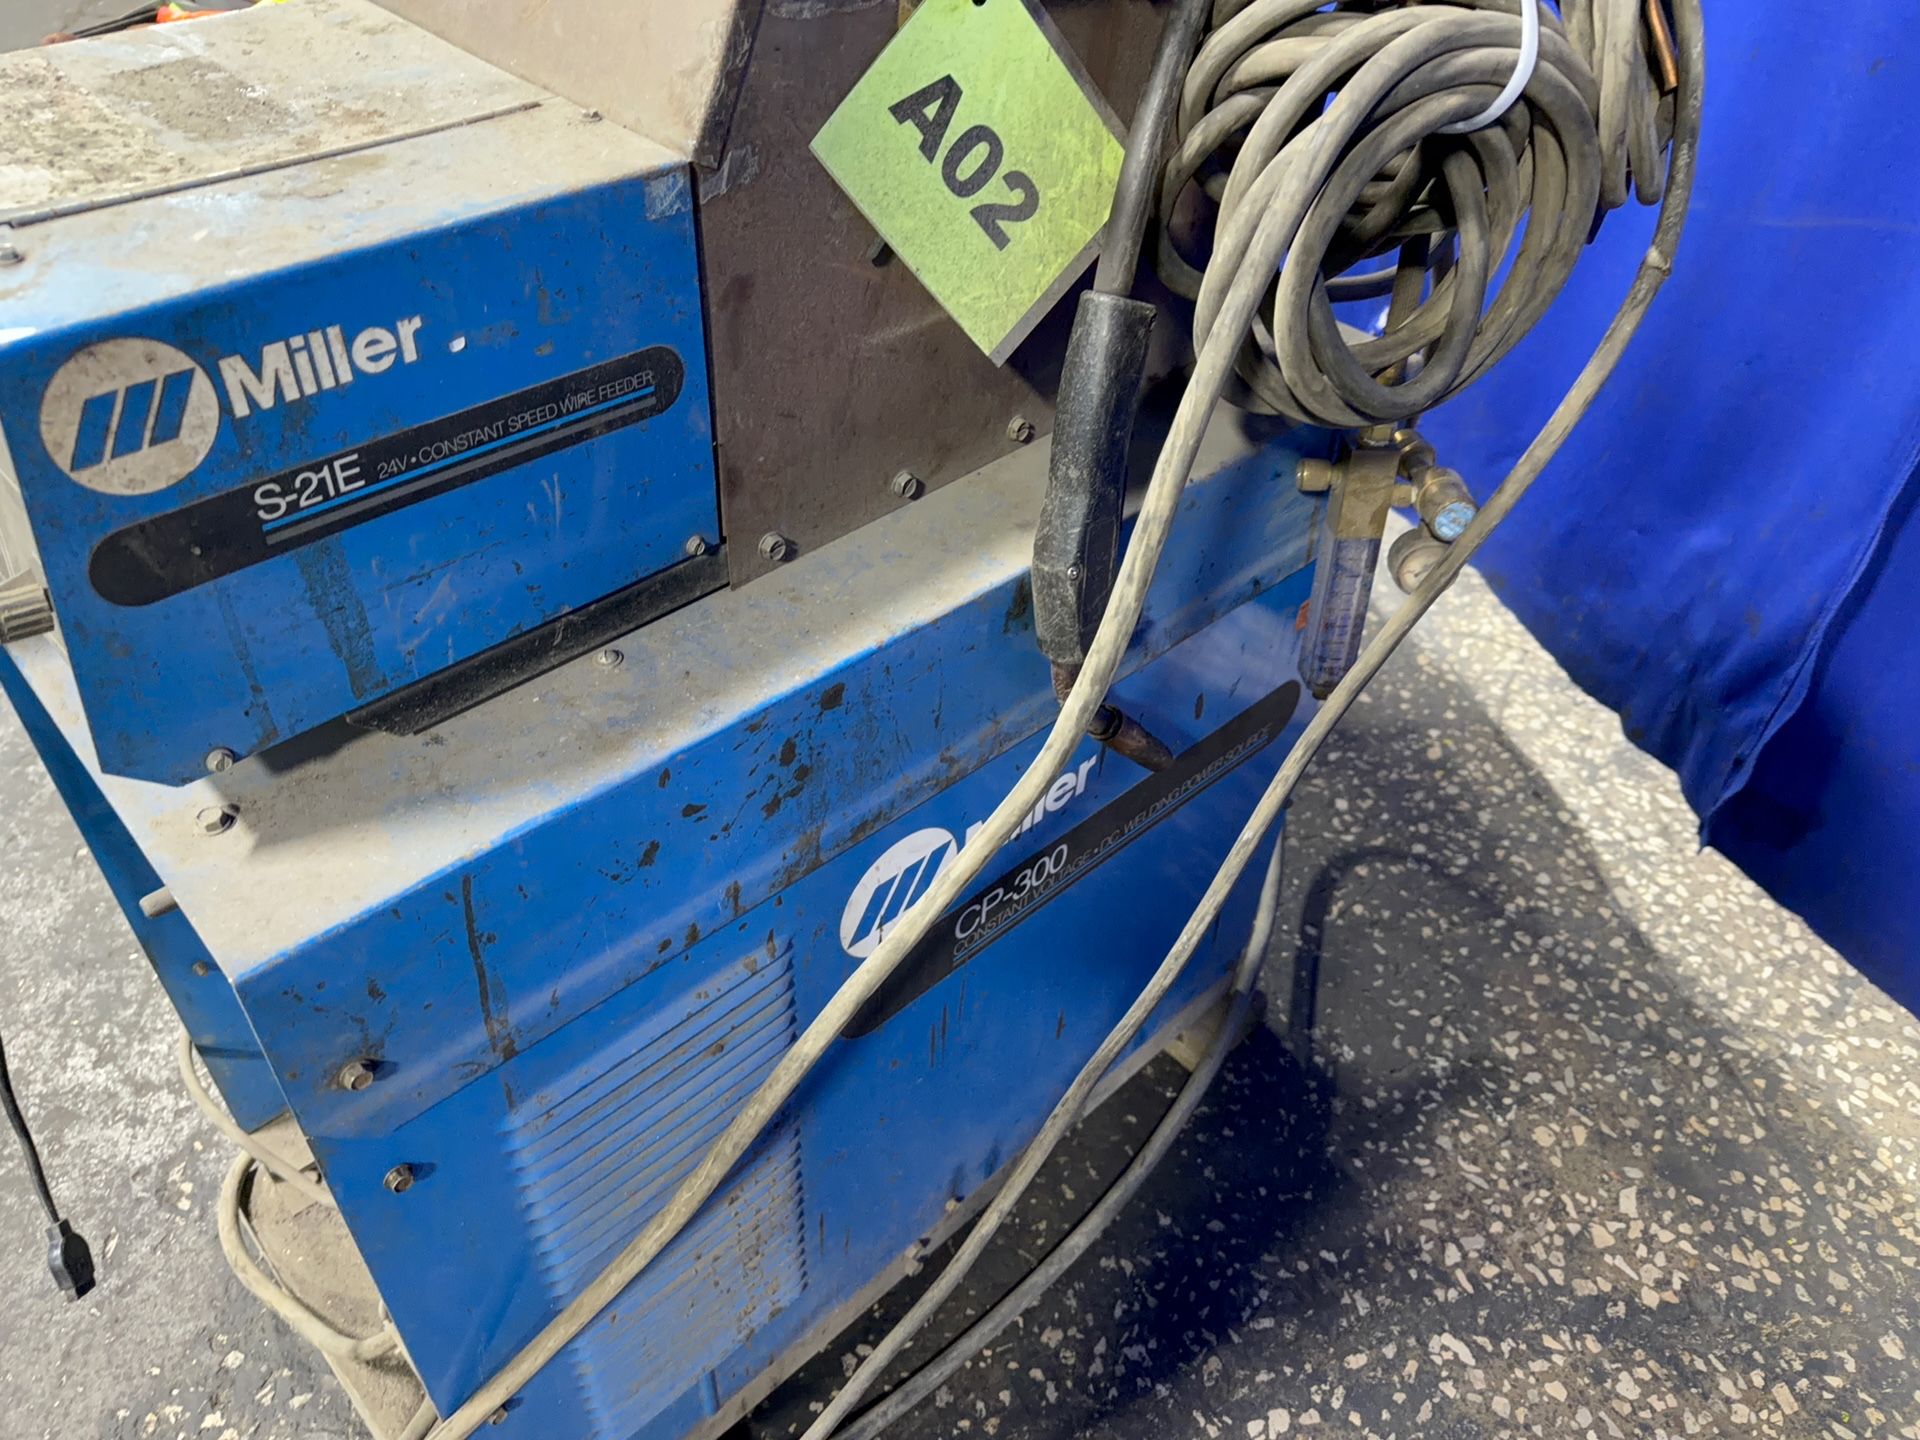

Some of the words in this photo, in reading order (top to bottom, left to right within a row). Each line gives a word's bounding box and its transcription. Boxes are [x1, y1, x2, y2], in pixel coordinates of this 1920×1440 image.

[888, 73, 1040, 251] A02
[218, 315, 422, 419] Miller
[254, 453, 365, 520] S-21E
[377, 455, 407, 479] 24V
[419, 420, 505, 463] CONSTANT
[508, 404, 557, 433] SPEED
[560, 388, 596, 413] WIRE
[599, 370, 655, 398] FEEDER
[953, 893, 1030, 955] CONSTANT
[1033, 849, 1092, 898] VOLTAGE
[1100, 829, 1120, 849] DC
[1124, 787, 1181, 834] WELDING
[1181, 757, 1223, 793] POWER
[955, 843, 1068, 939] CP-300
